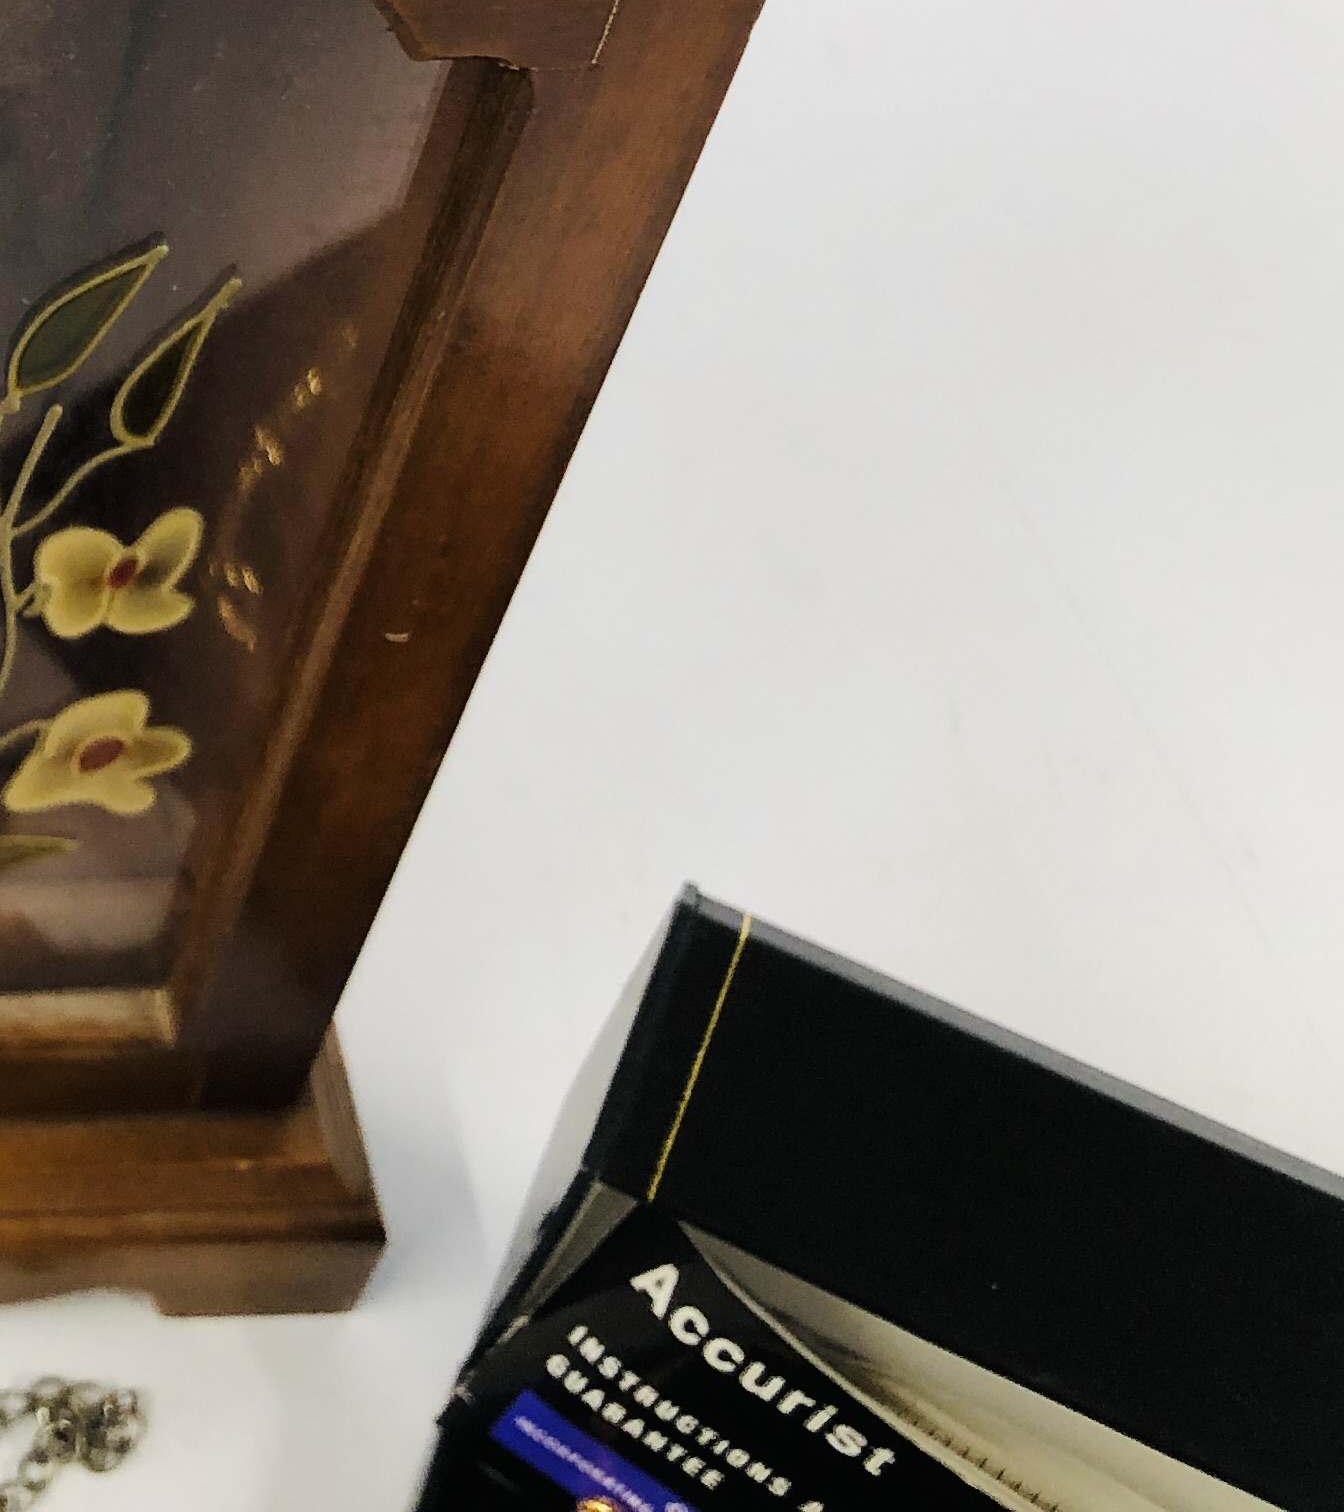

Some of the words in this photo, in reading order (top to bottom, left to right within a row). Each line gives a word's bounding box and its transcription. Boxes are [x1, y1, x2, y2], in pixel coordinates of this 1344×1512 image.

[545, 1353, 726, 1490] GUARANTEE
[567, 1324, 792, 1497] INSTRUCTIONS
[629, 1263, 896, 1477] Accurist
